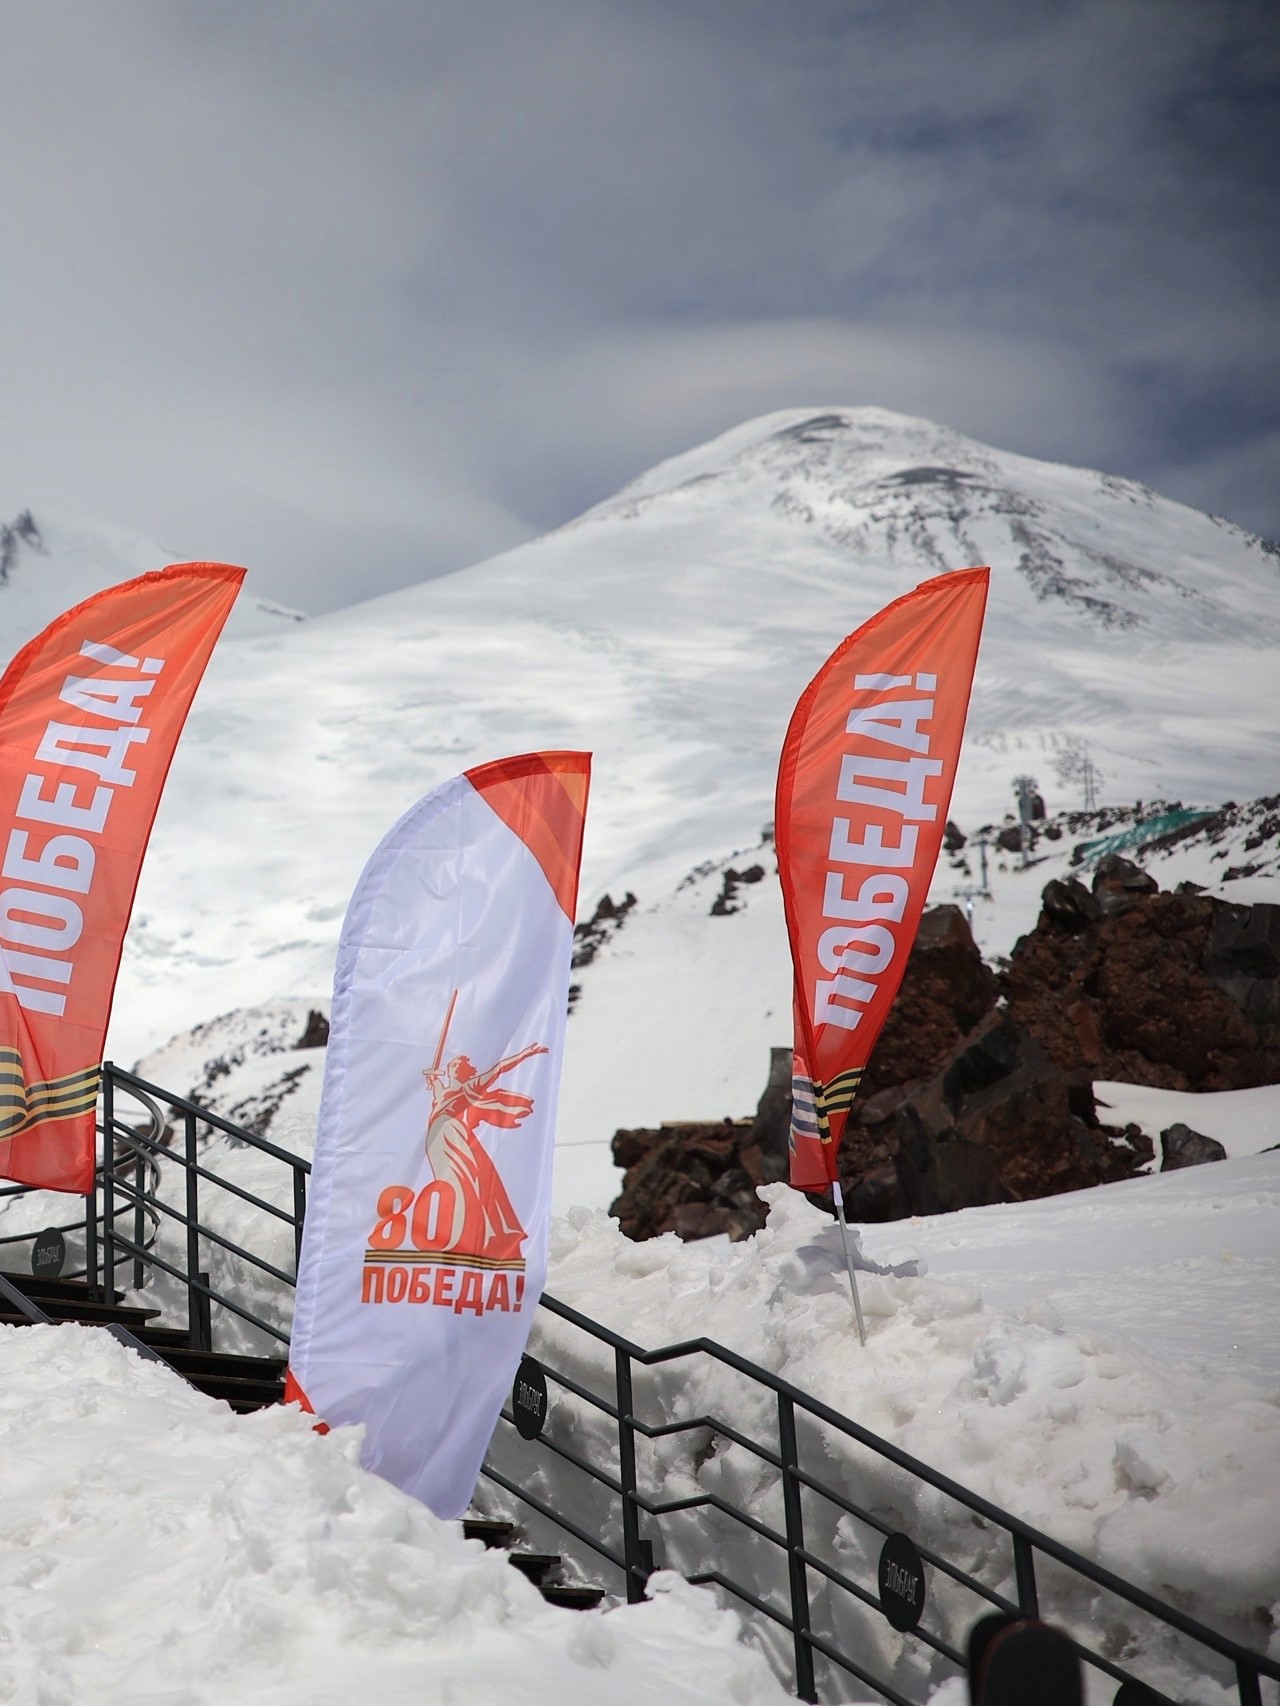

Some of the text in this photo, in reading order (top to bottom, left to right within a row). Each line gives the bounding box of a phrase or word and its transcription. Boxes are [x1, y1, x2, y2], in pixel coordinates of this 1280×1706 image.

[813, 672, 945, 1031] ПОБЕДА!
[367, 1179, 458, 1252] 80
[361, 1265, 526, 1317] ПОБЕДА!
[884, 1559, 919, 1606] ЭЛЬБРУС
